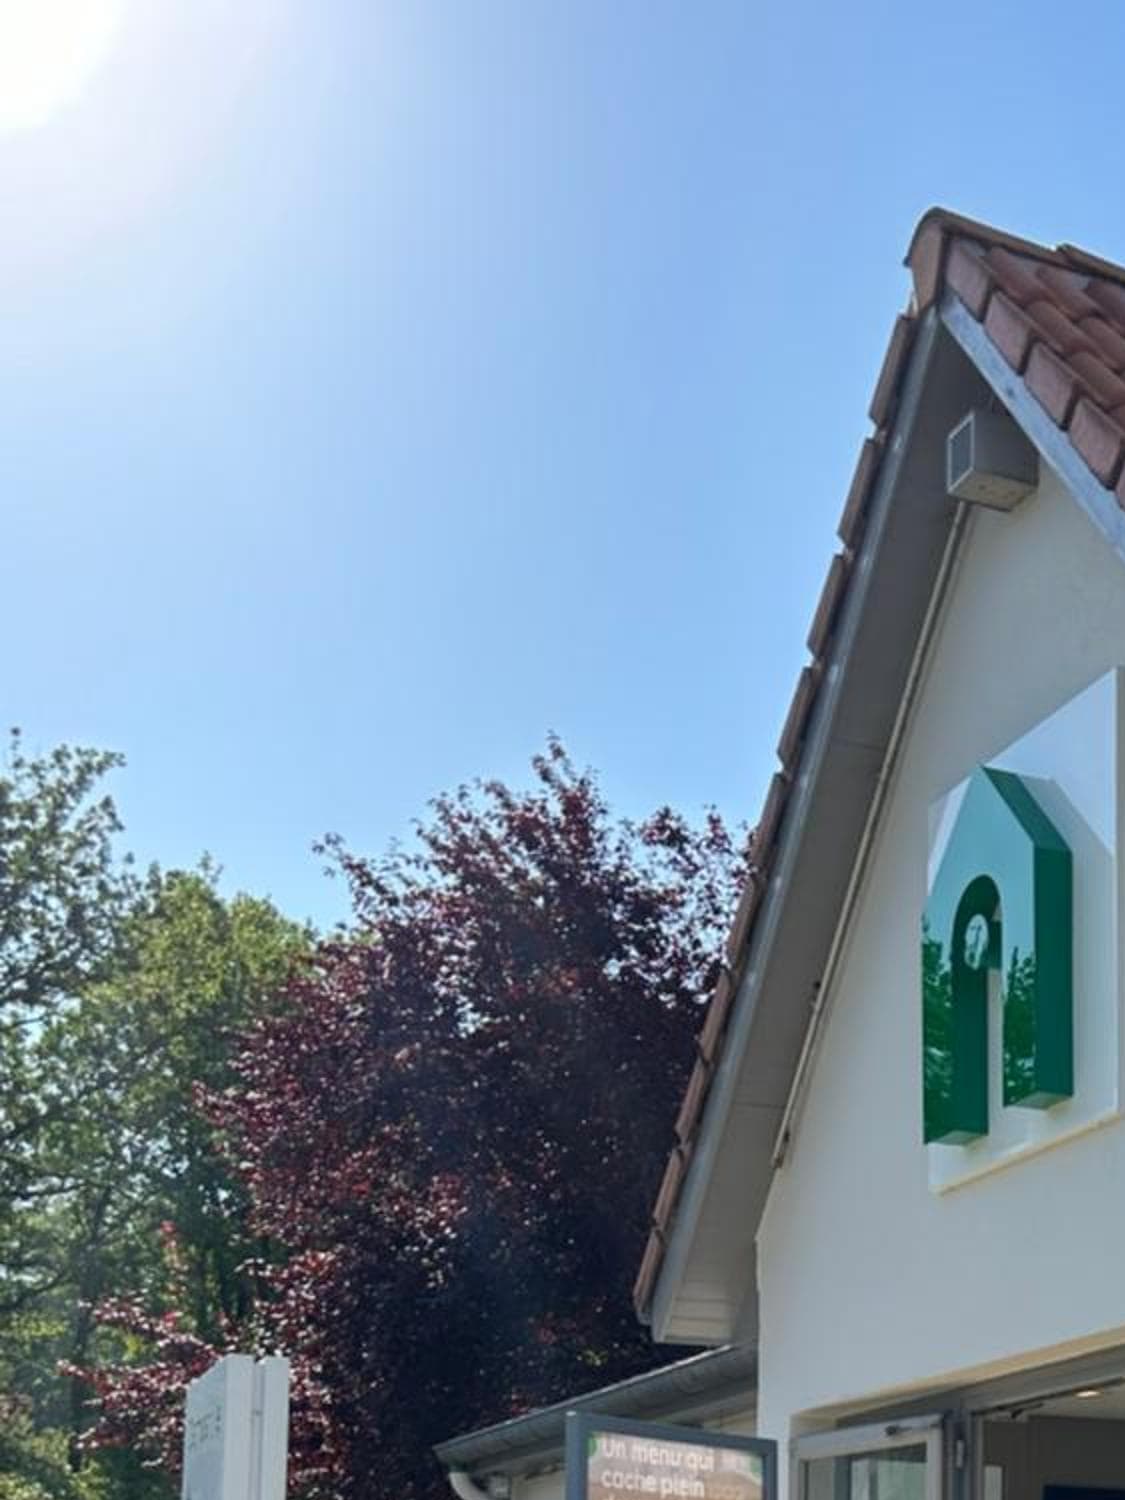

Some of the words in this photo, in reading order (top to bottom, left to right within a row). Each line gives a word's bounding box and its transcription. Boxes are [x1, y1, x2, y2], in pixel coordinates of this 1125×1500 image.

[602, 1437, 626, 1458] Un
[631, 1444, 682, 1467] menu
[687, 1449, 715, 1472] qui
[601, 1469, 657, 1492] cache
[660, 1474, 704, 1500] plein
